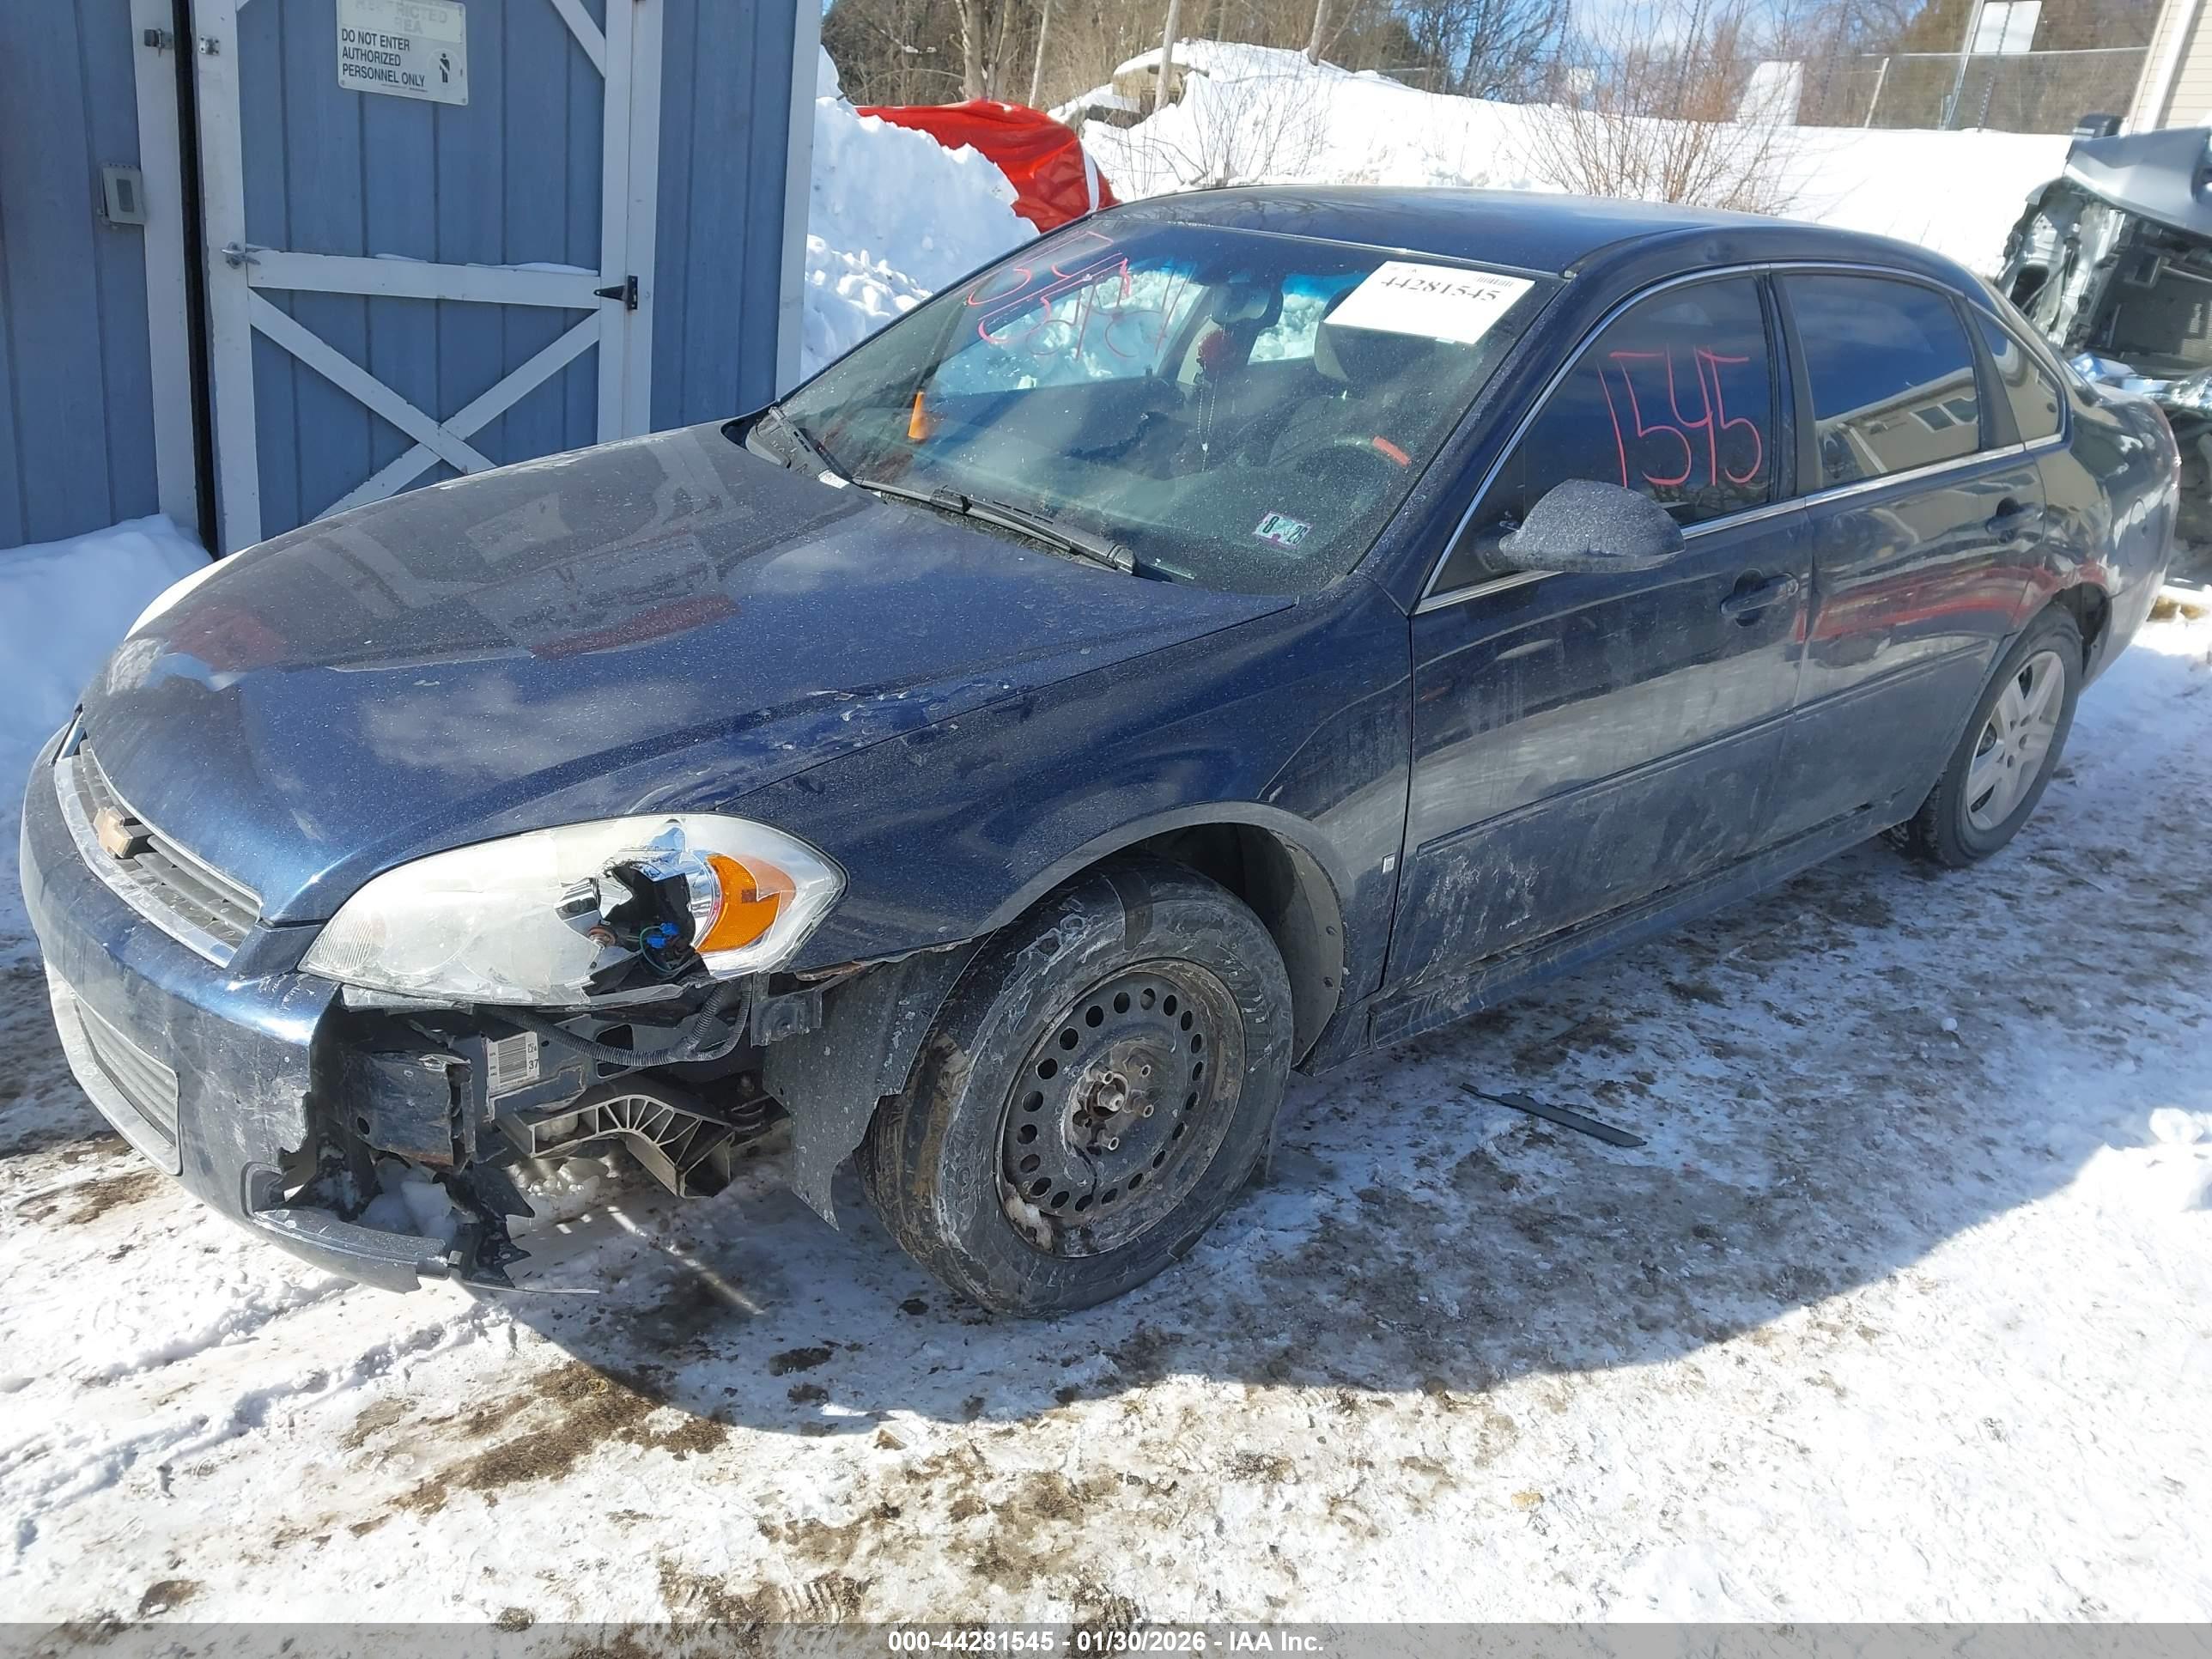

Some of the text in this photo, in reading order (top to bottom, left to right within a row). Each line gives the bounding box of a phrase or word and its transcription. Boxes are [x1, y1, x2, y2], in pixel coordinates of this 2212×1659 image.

[355, 0, 448, 23] RERICTED
[342, 28, 410, 52] DO NOT ENTER
[342, 47, 401, 67] AUTHORIZED
[342, 63, 425, 88] PERSONNEL ONLY
[1381, 276, 1502, 301] 44281545
[1595, 342, 1762, 489] 1545
[1262, 515, 1308, 544] 8 26
[528, 1058, 539, 1070] 37
